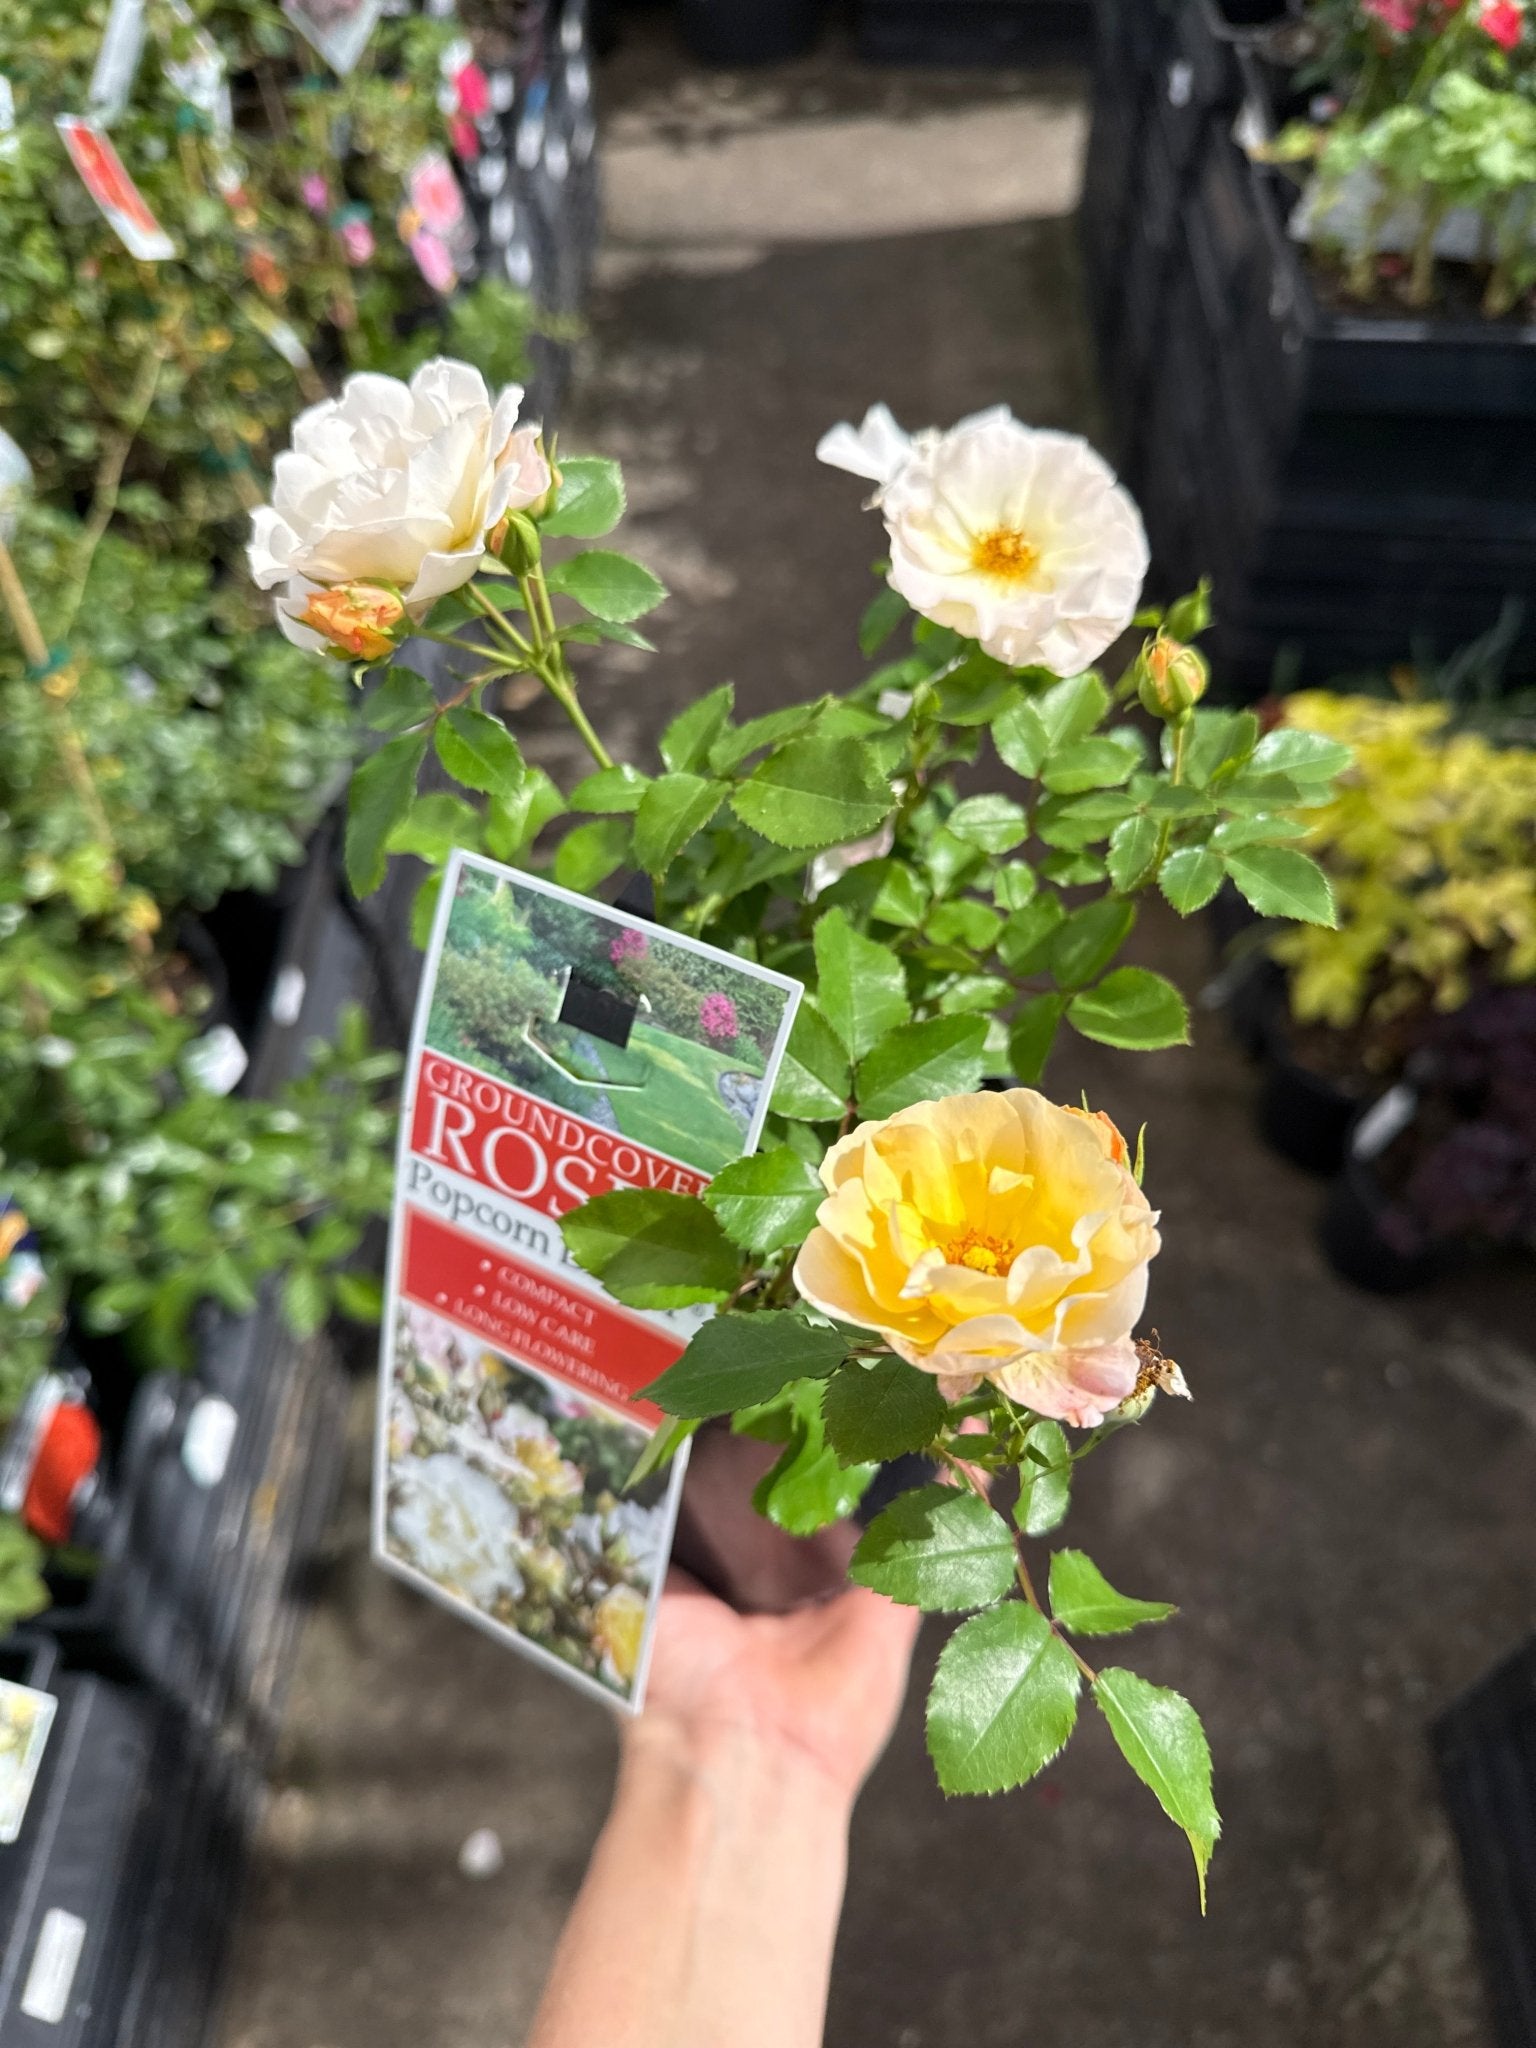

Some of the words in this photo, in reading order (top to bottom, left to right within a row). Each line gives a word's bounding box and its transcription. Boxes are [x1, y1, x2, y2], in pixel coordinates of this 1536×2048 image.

[422, 1091, 648, 1221] ROS
[407, 1160, 549, 1256] Popcorn
[491, 1290, 540, 1327] LOW
[539, 1316, 597, 1355] CARE
[497, 1266, 597, 1327] COMPACT
[453, 1298, 513, 1342] LONG
[510, 1328, 630, 1402] FLOWERING
